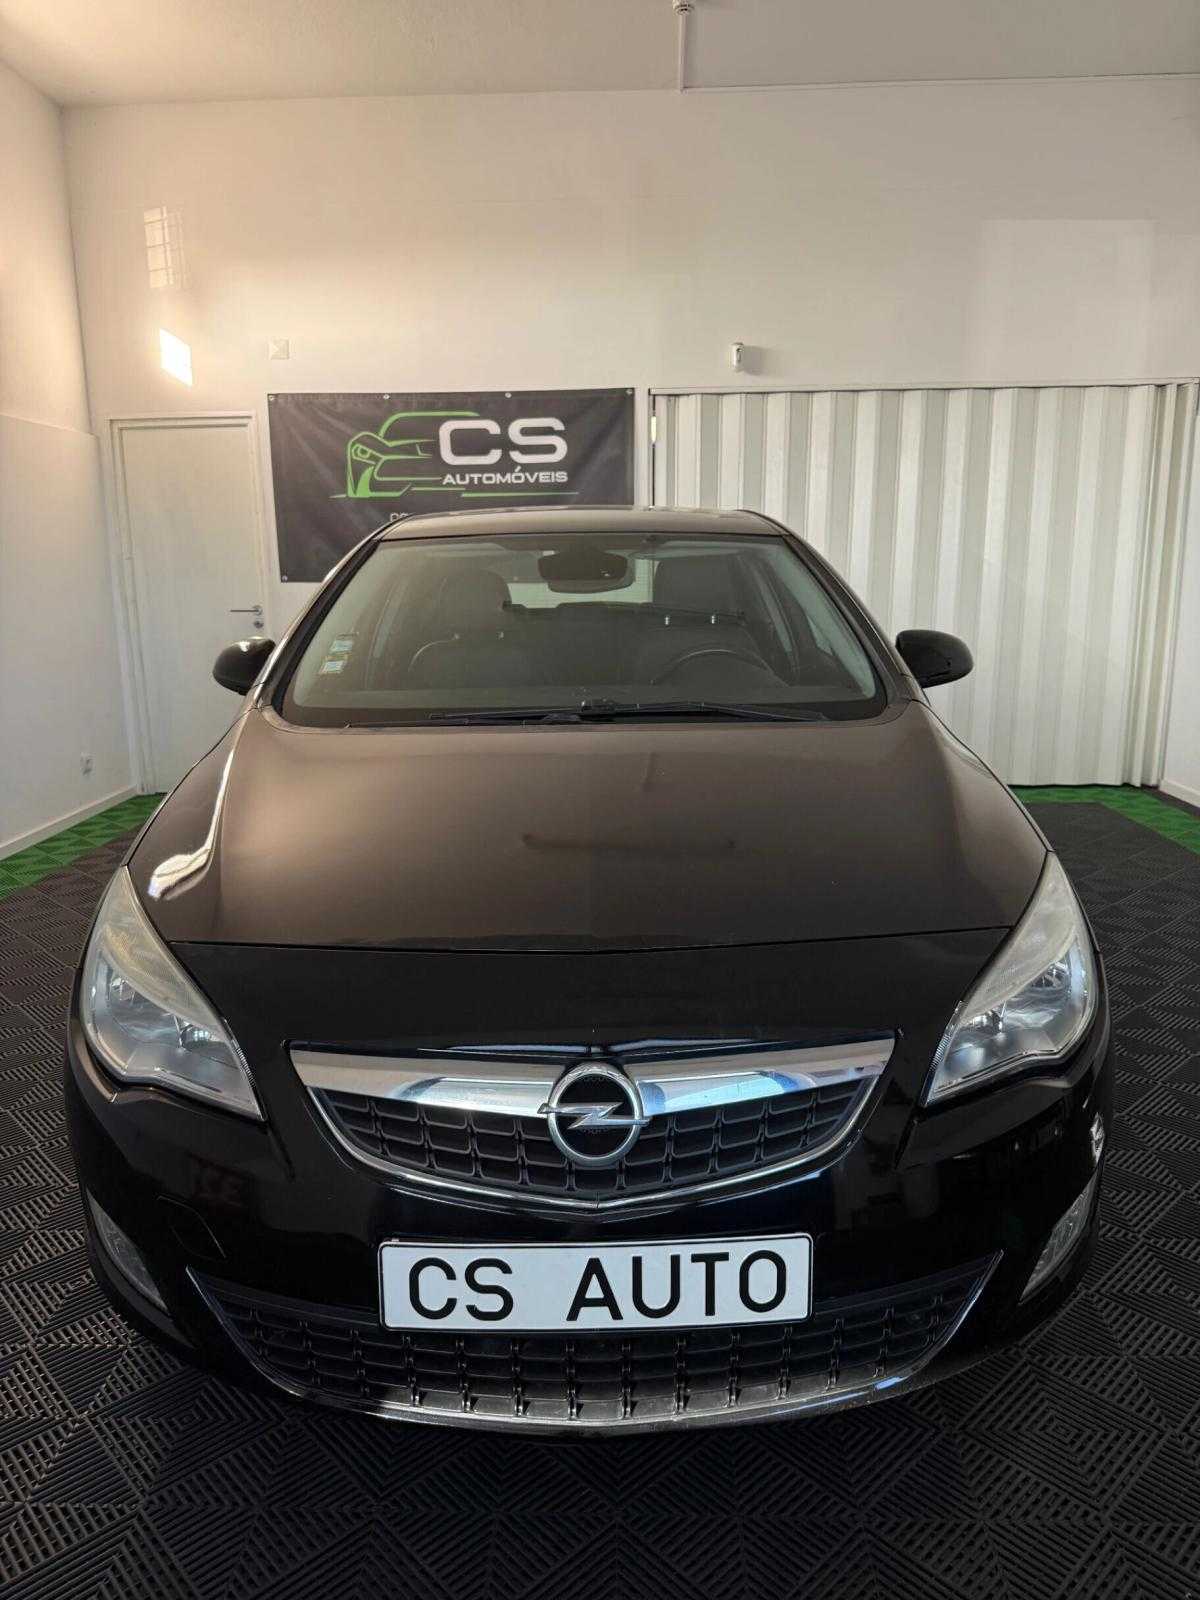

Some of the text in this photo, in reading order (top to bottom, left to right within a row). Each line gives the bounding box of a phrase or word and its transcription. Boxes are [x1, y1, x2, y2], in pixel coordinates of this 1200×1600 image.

[439, 417, 568, 465] CS
[442, 466, 568, 485] AUTOMÓVEIS
[409, 1250, 787, 1321] CS AUTO
